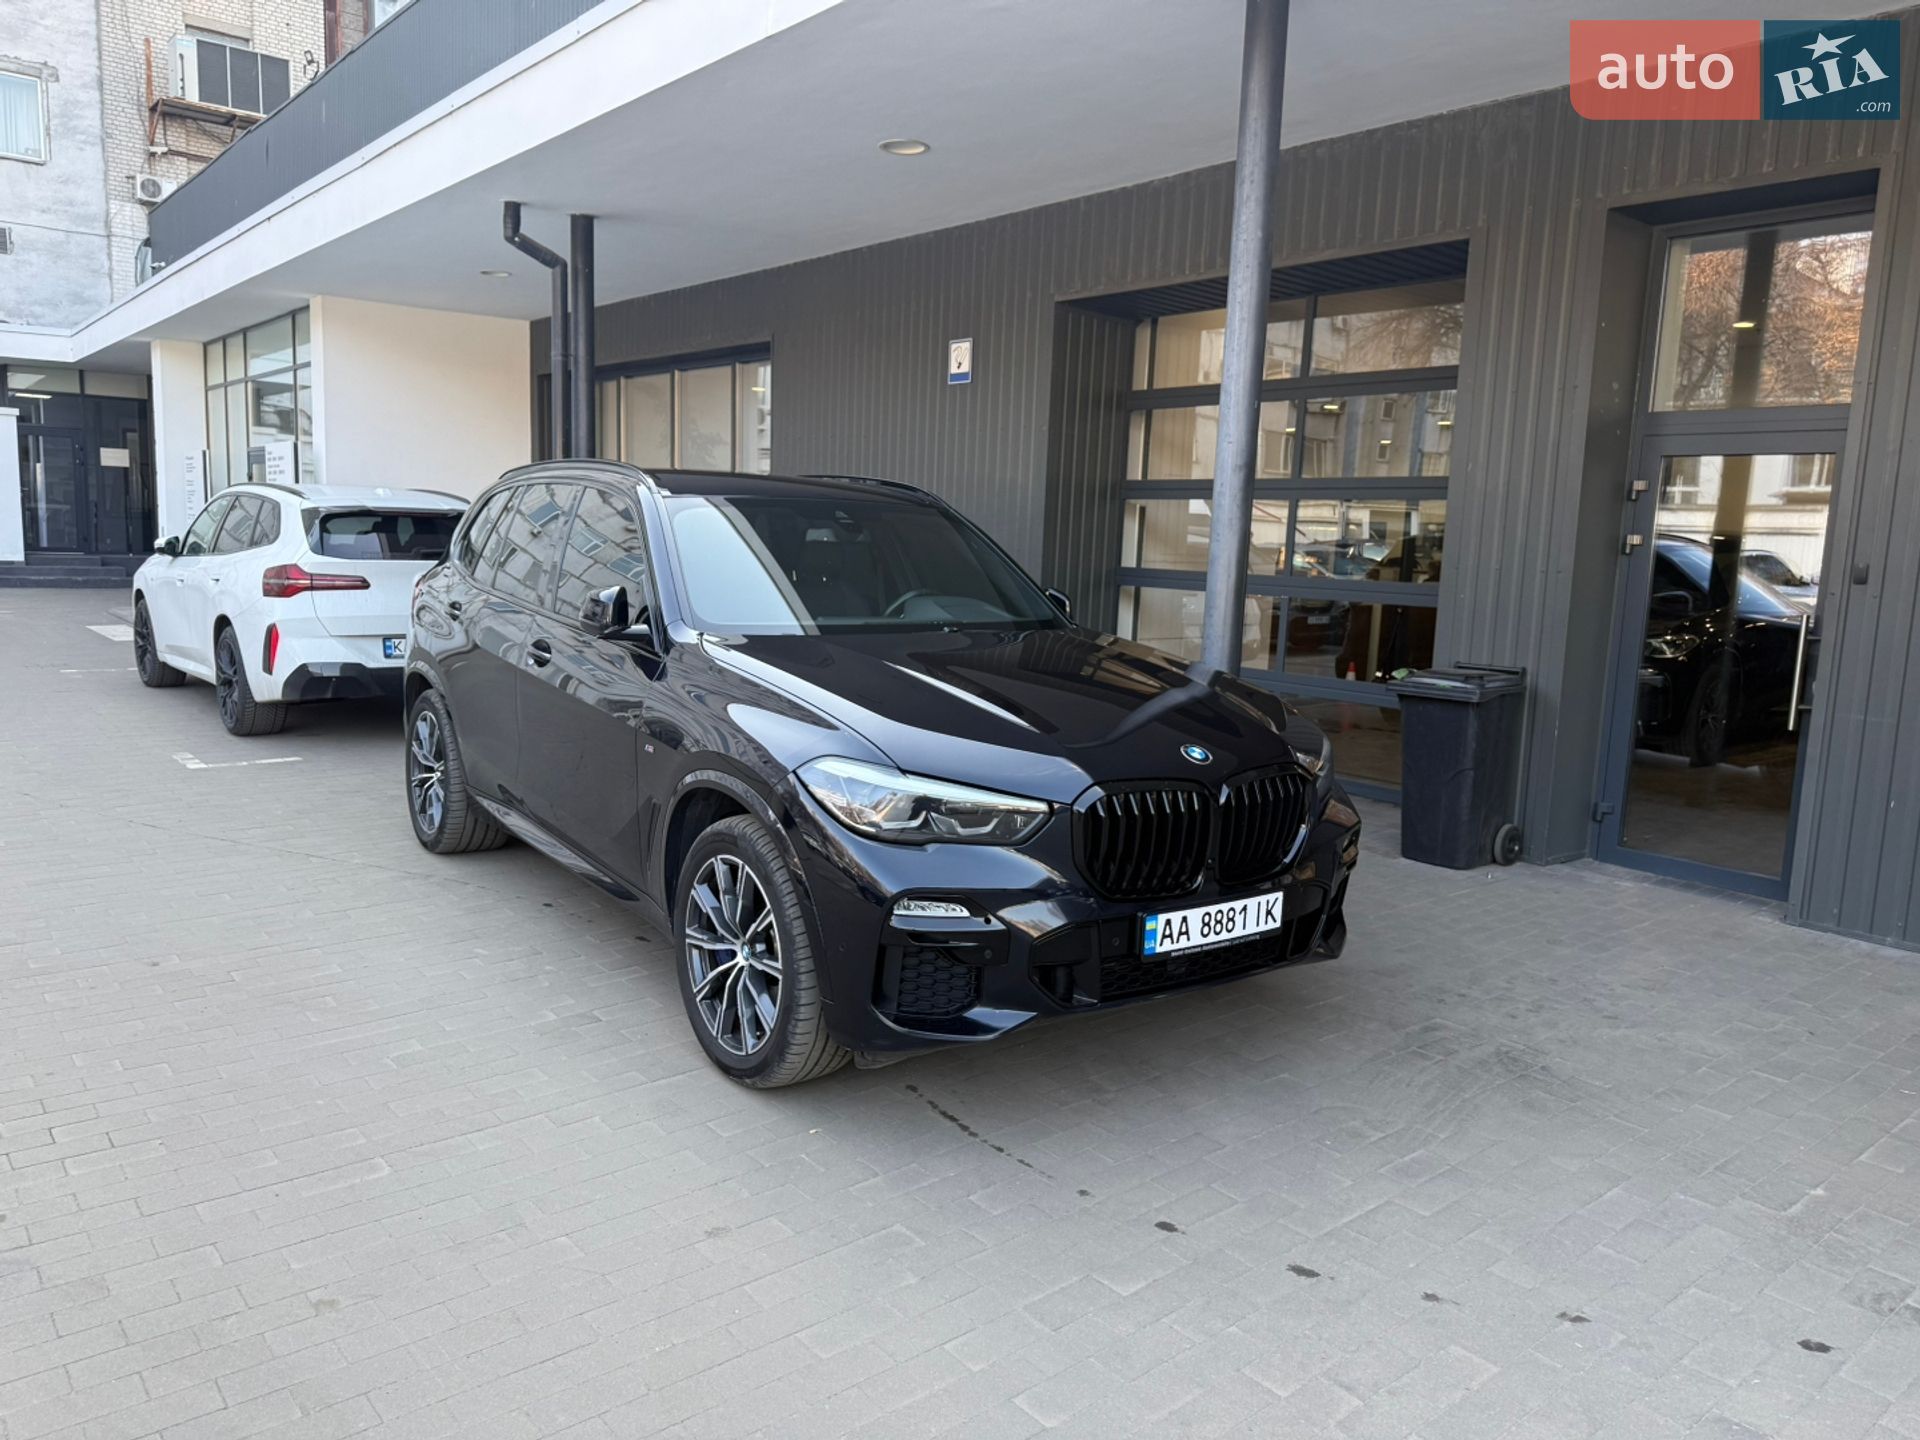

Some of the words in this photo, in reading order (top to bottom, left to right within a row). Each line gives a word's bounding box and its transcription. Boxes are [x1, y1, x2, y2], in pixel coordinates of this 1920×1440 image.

[1159, 915, 1190, 947] AA
[1200, 904, 1248, 938] 8881
[1256, 896, 1279, 927] IK
